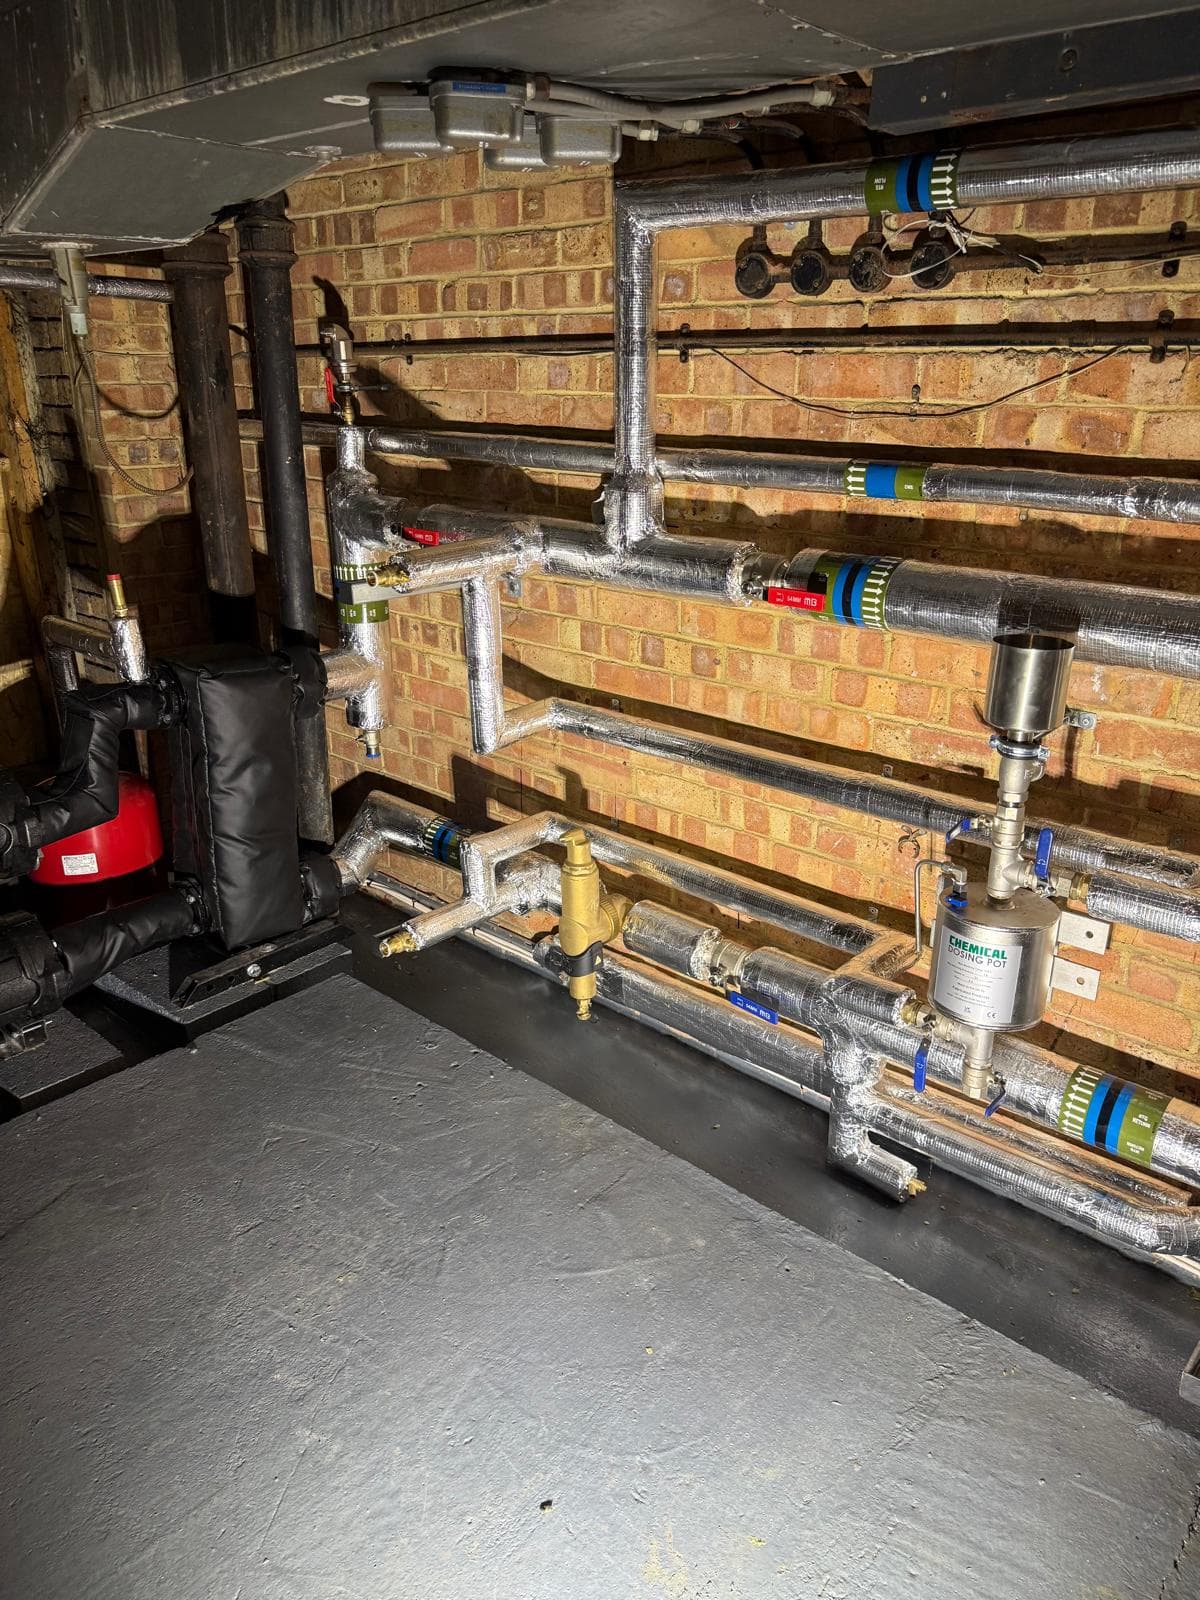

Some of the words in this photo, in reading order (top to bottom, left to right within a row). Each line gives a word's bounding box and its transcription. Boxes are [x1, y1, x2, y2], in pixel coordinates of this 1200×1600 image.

[948, 945, 984, 965] DOSING
[987, 958, 1007, 969] POT
[949, 935, 1008, 960] CHEMICAL
